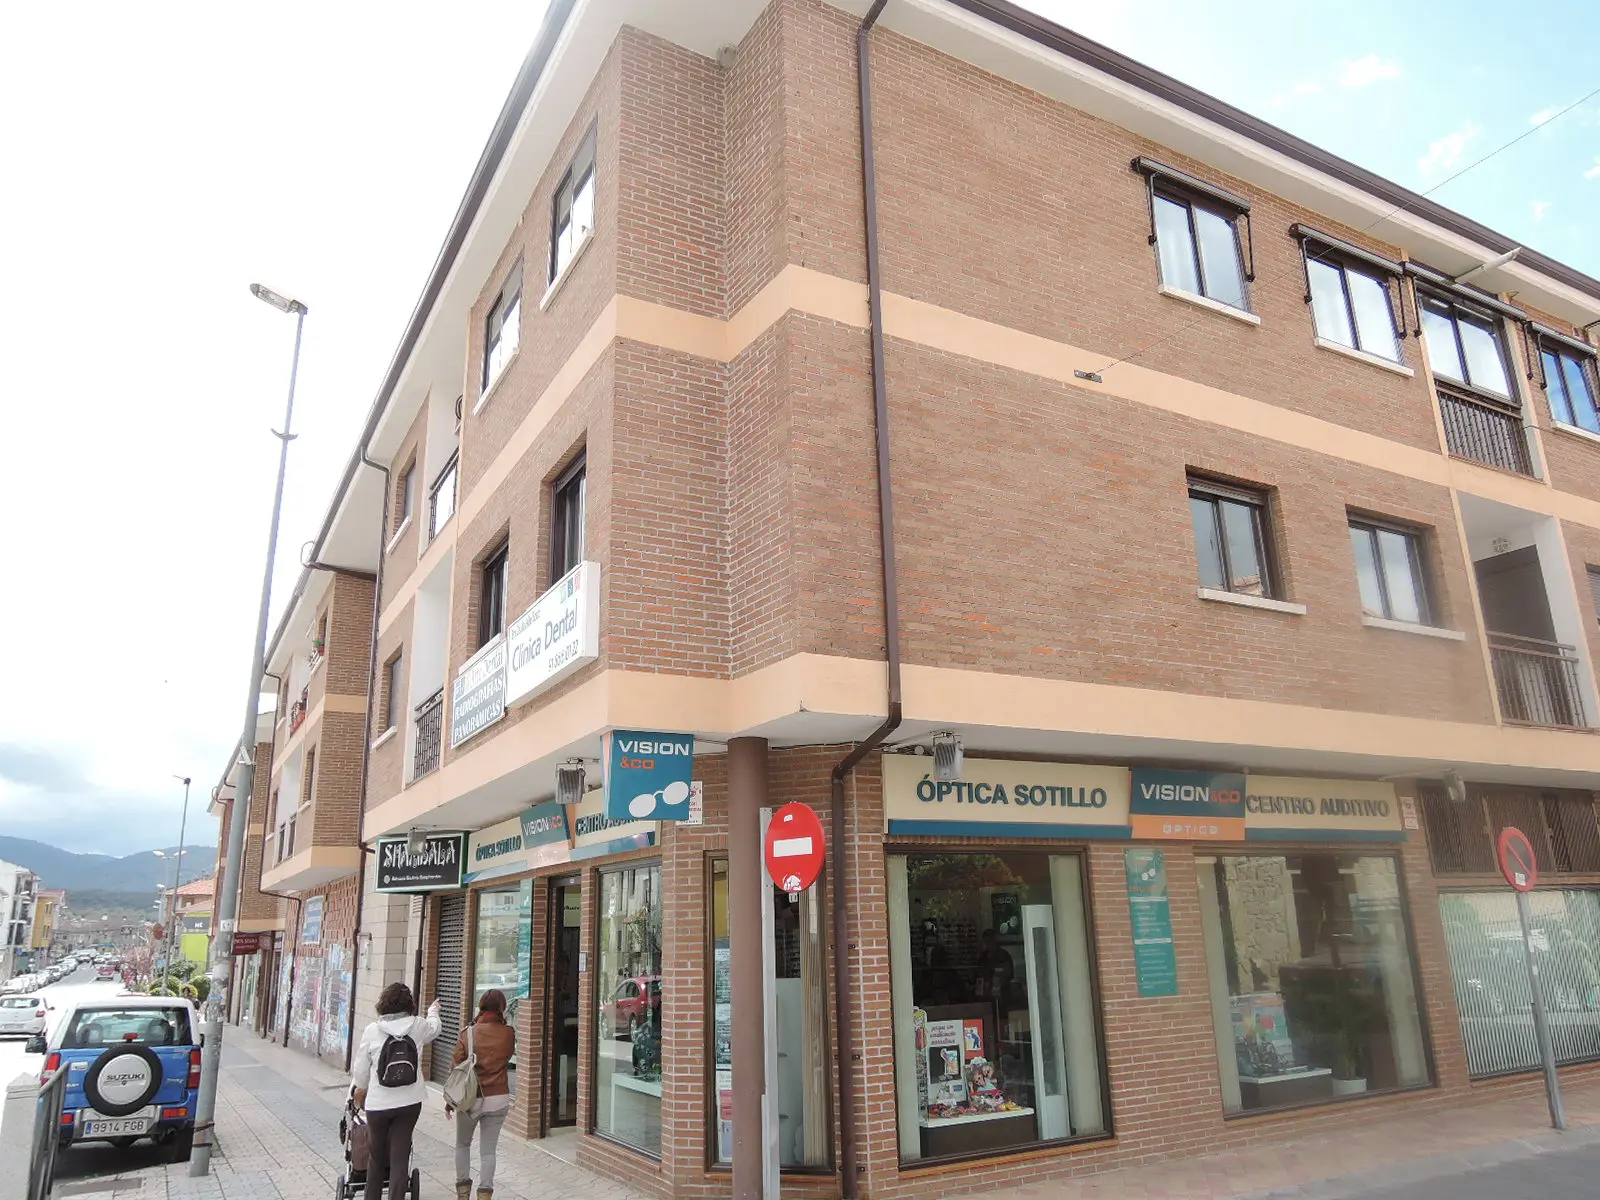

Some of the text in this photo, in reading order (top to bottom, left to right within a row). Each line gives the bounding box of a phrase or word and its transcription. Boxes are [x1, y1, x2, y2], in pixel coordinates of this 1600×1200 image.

[512, 637, 541, 672] Clínica
[545, 598, 578, 651] Dental
[618, 740, 689, 755] VISION
[620, 756, 655, 770] &CO
[917, 774, 1107, 808] ÓPTICA SOTILLO
[1245, 794, 1316, 815] CENTRO
[1320, 797, 1390, 817] AUDITIVO
[575, 813, 607, 836] CENTRO
[106, 1073, 145, 1081] SUZUKI
[93, 1121, 144, 1133] 9914 FGB
